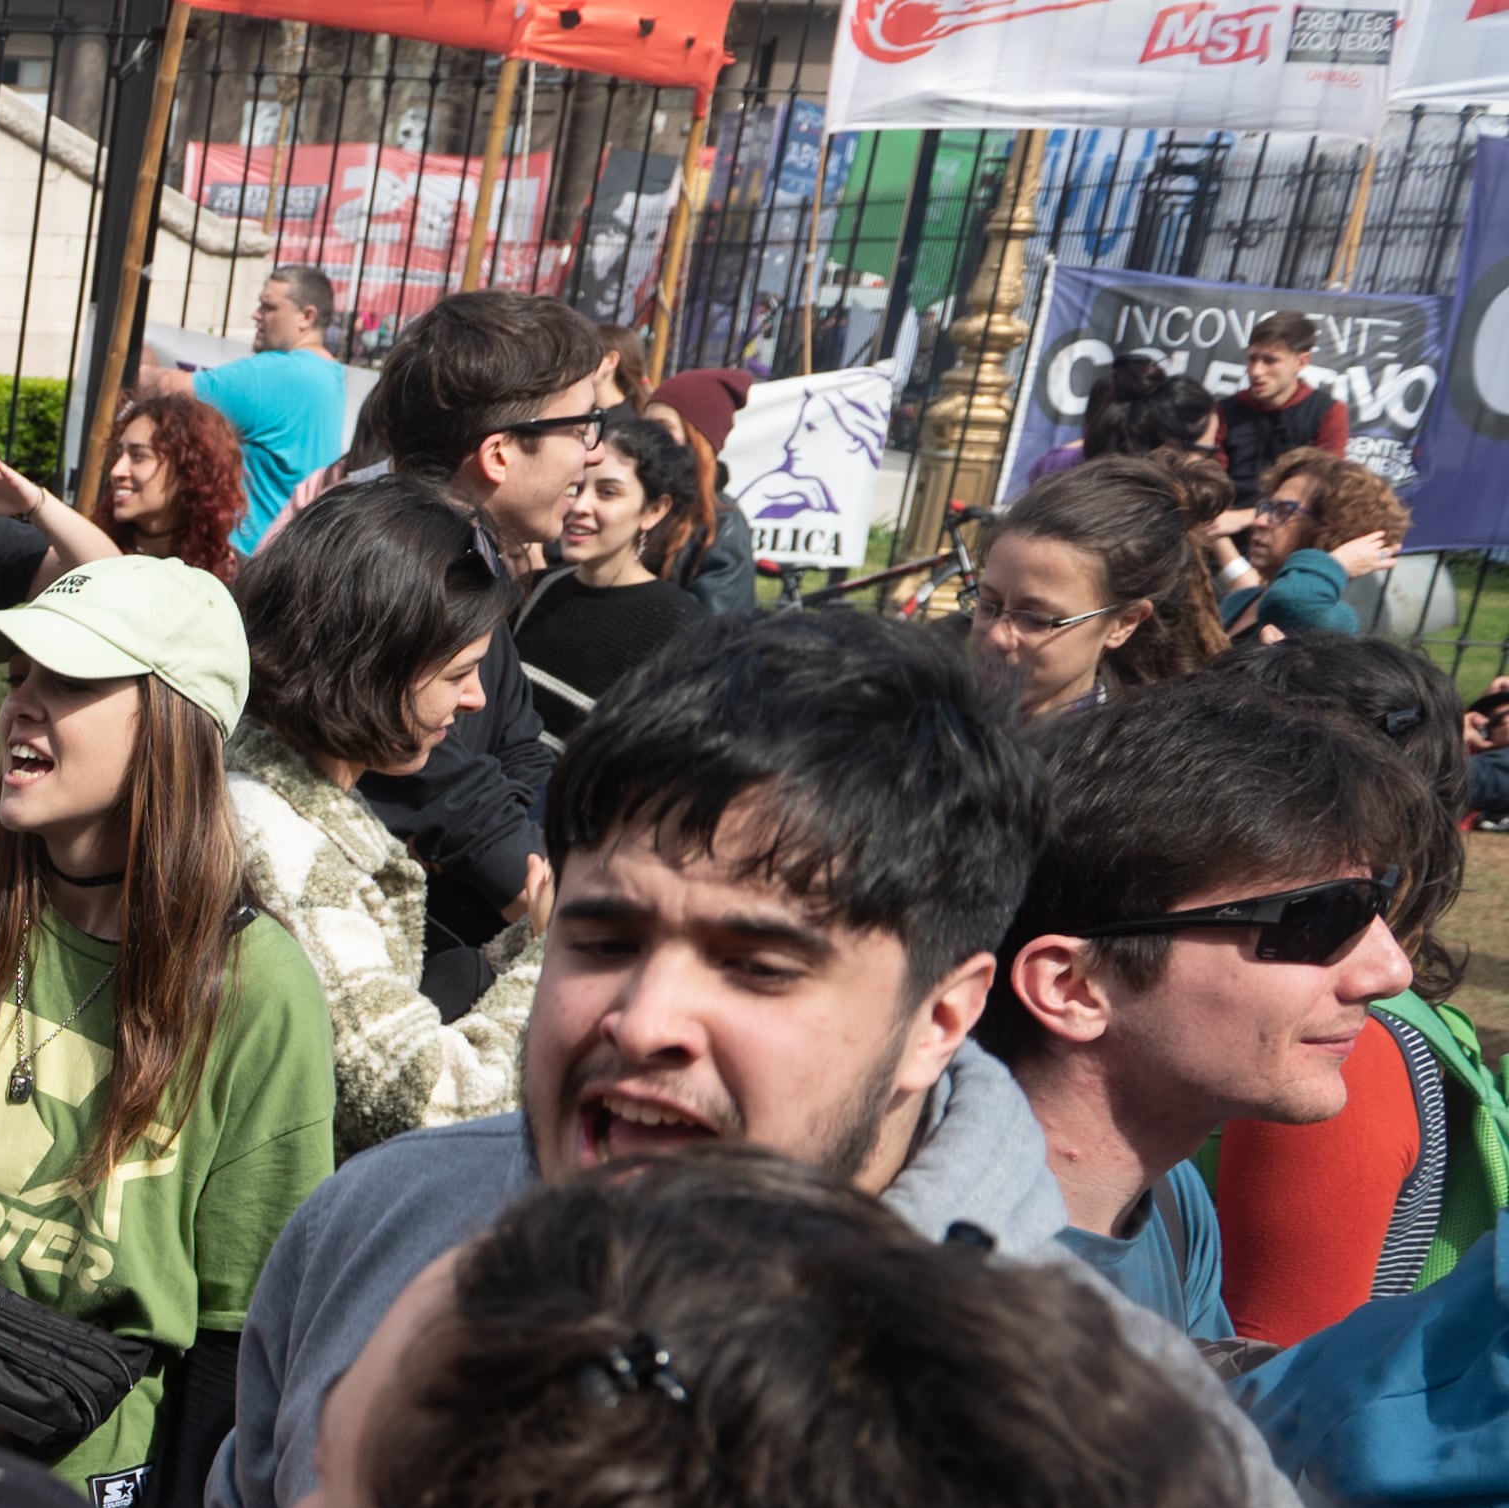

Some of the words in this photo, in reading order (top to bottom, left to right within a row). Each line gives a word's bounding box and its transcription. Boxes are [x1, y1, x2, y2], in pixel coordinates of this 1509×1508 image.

[1144, 6, 1280, 61] MST
[1295, 11, 1374, 32] FRENTE
[1375, 15, 1393, 32] DE
[1292, 31, 1390, 51] IZQUIERDA
[750, 527, 842, 556] BLICA
